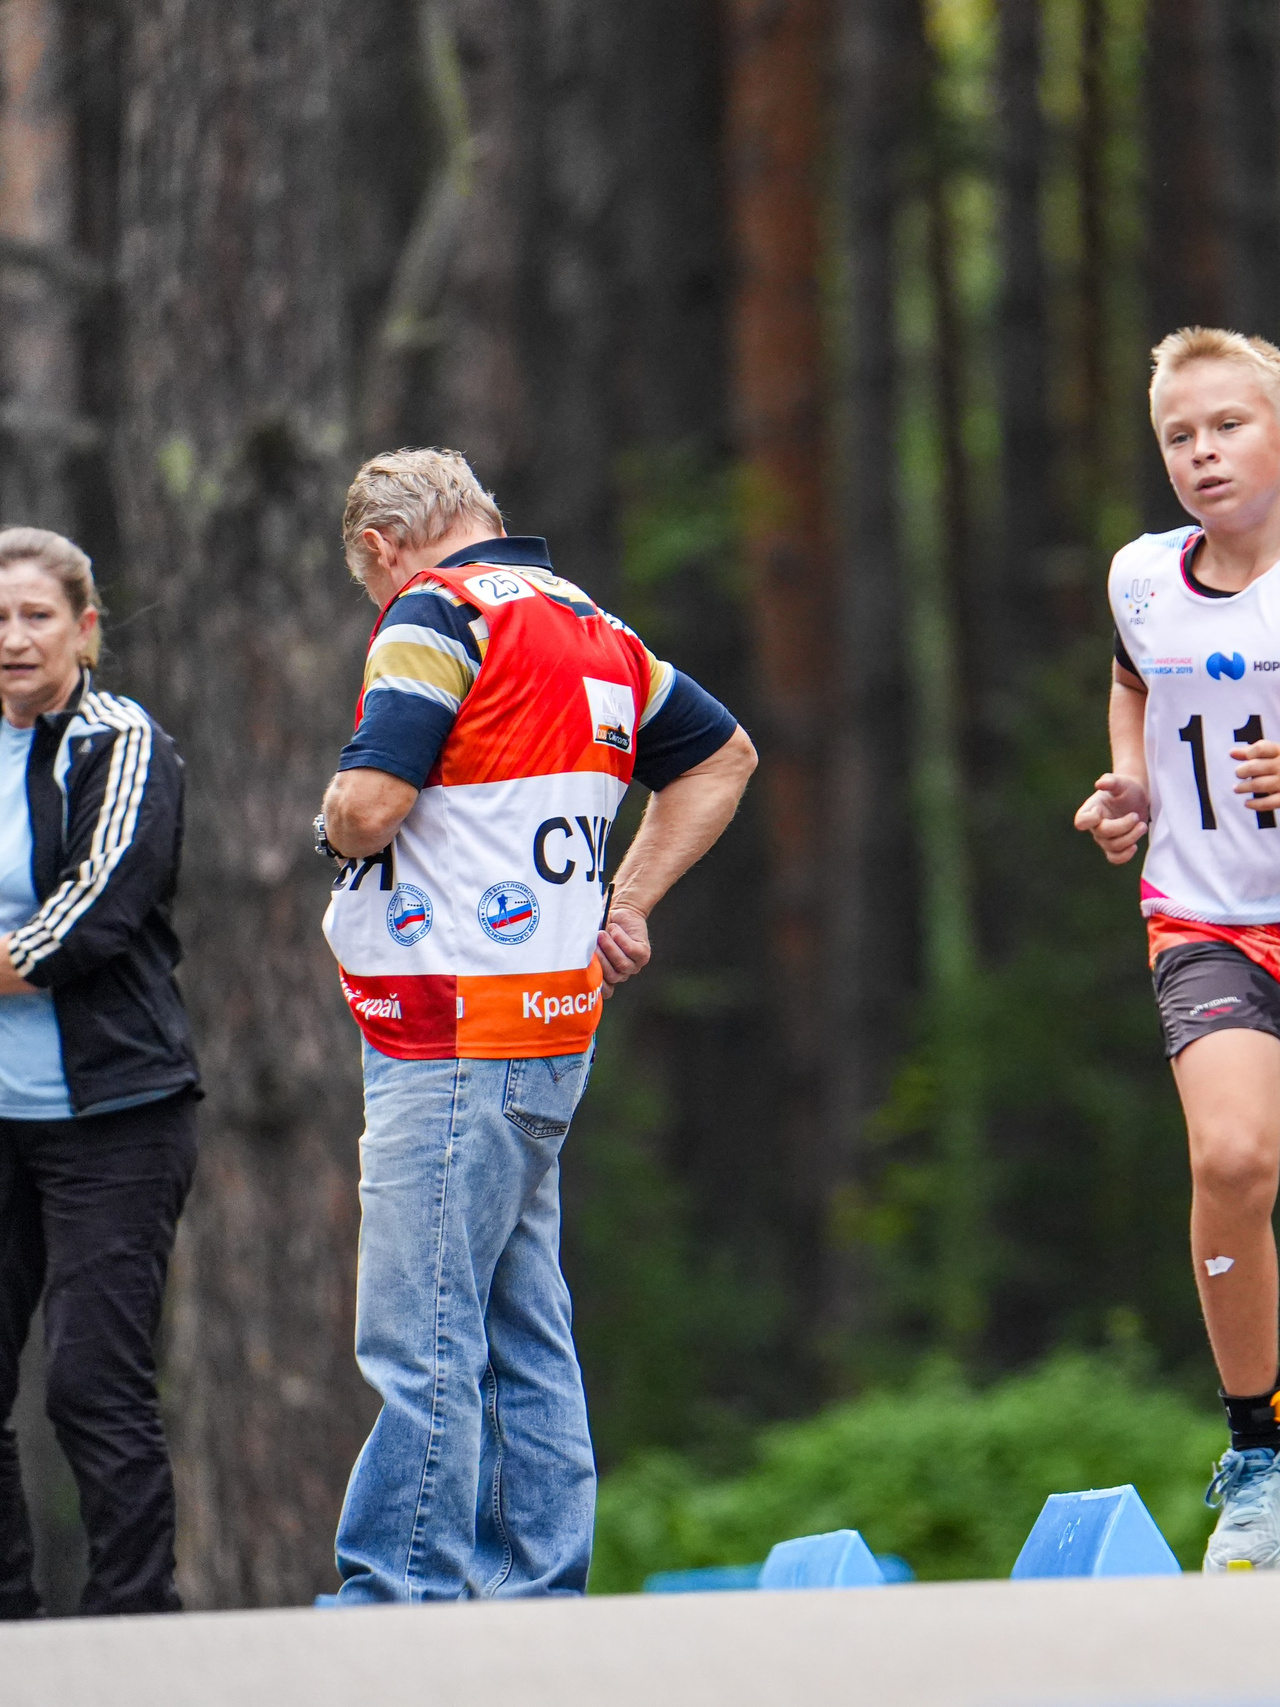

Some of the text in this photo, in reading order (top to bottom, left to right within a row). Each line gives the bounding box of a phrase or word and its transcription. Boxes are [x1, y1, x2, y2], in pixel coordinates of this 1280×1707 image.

[478, 573, 520, 599] 25
[1176, 666, 1193, 674] 2019
[480, 883, 537, 910] СОЮЗ БИАТЛОНИСТОВ
